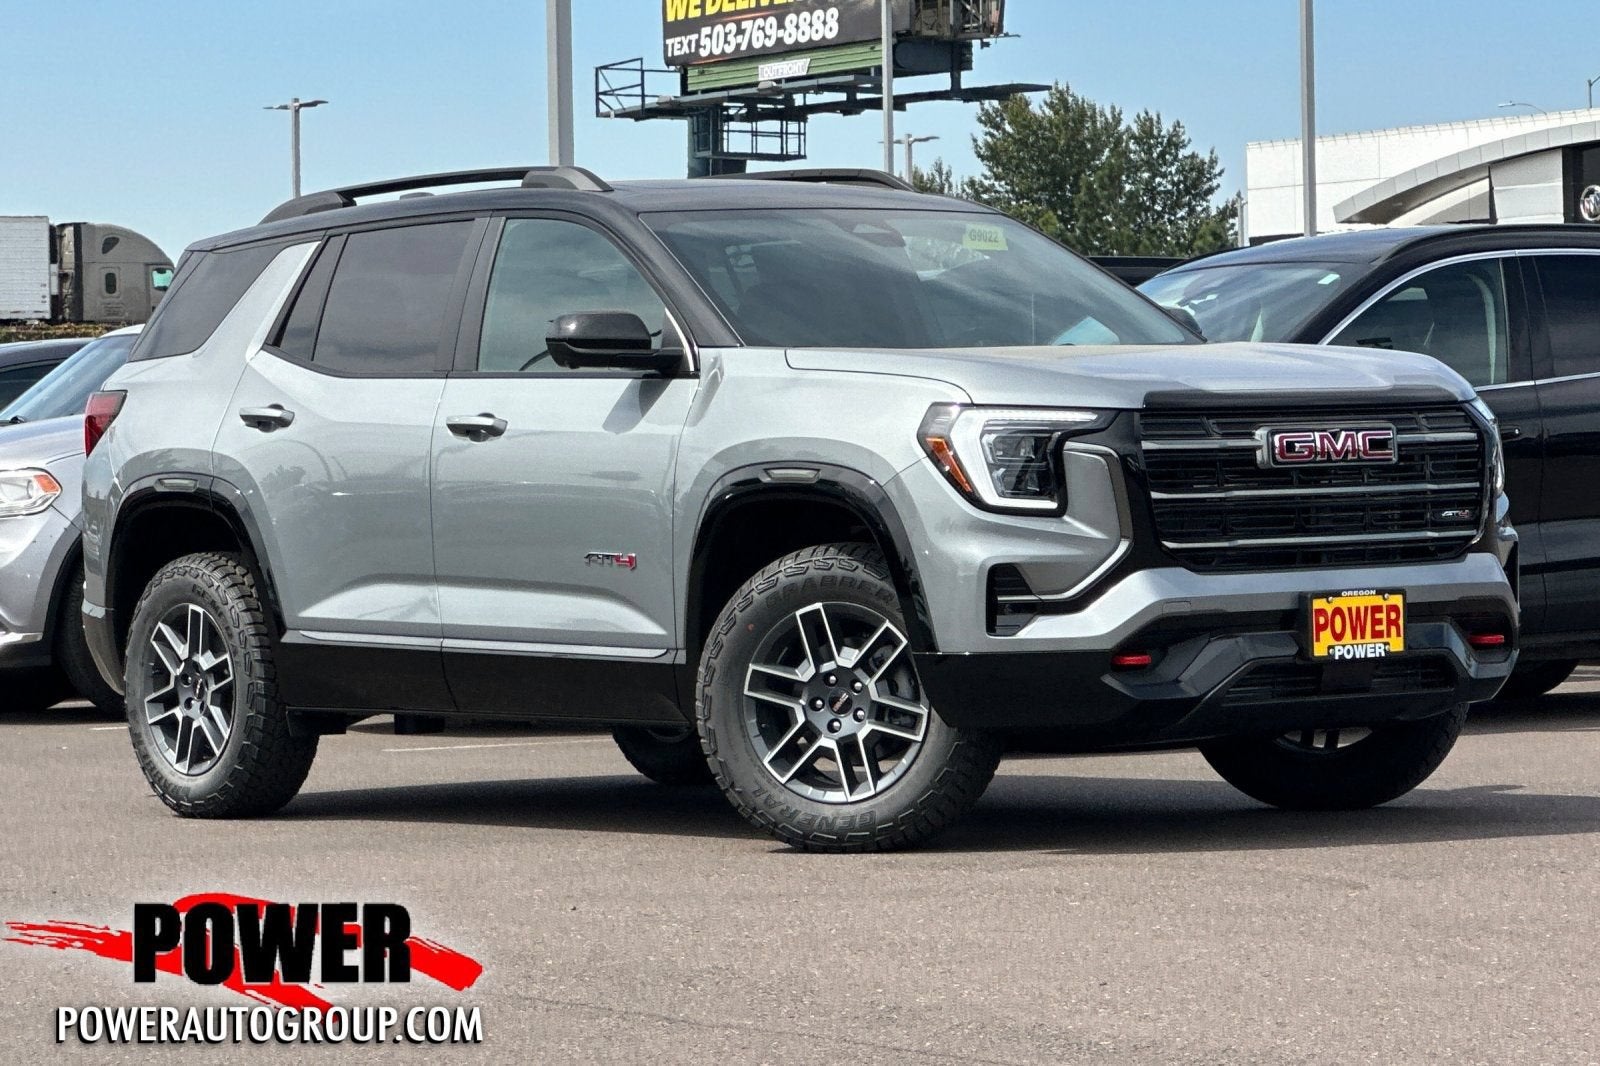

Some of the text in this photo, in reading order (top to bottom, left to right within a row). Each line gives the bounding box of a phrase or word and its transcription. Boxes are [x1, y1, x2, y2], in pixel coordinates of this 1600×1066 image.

[666, 34, 699, 57] TEXT
[699, 7, 839, 58] 503-769-8888
[968, 229, 999, 243] G9022
[1274, 430, 1393, 462] GMC
[1341, 589, 1376, 597] OREGON
[1314, 604, 1402, 643] POWER
[1334, 643, 1386, 660] POWER
